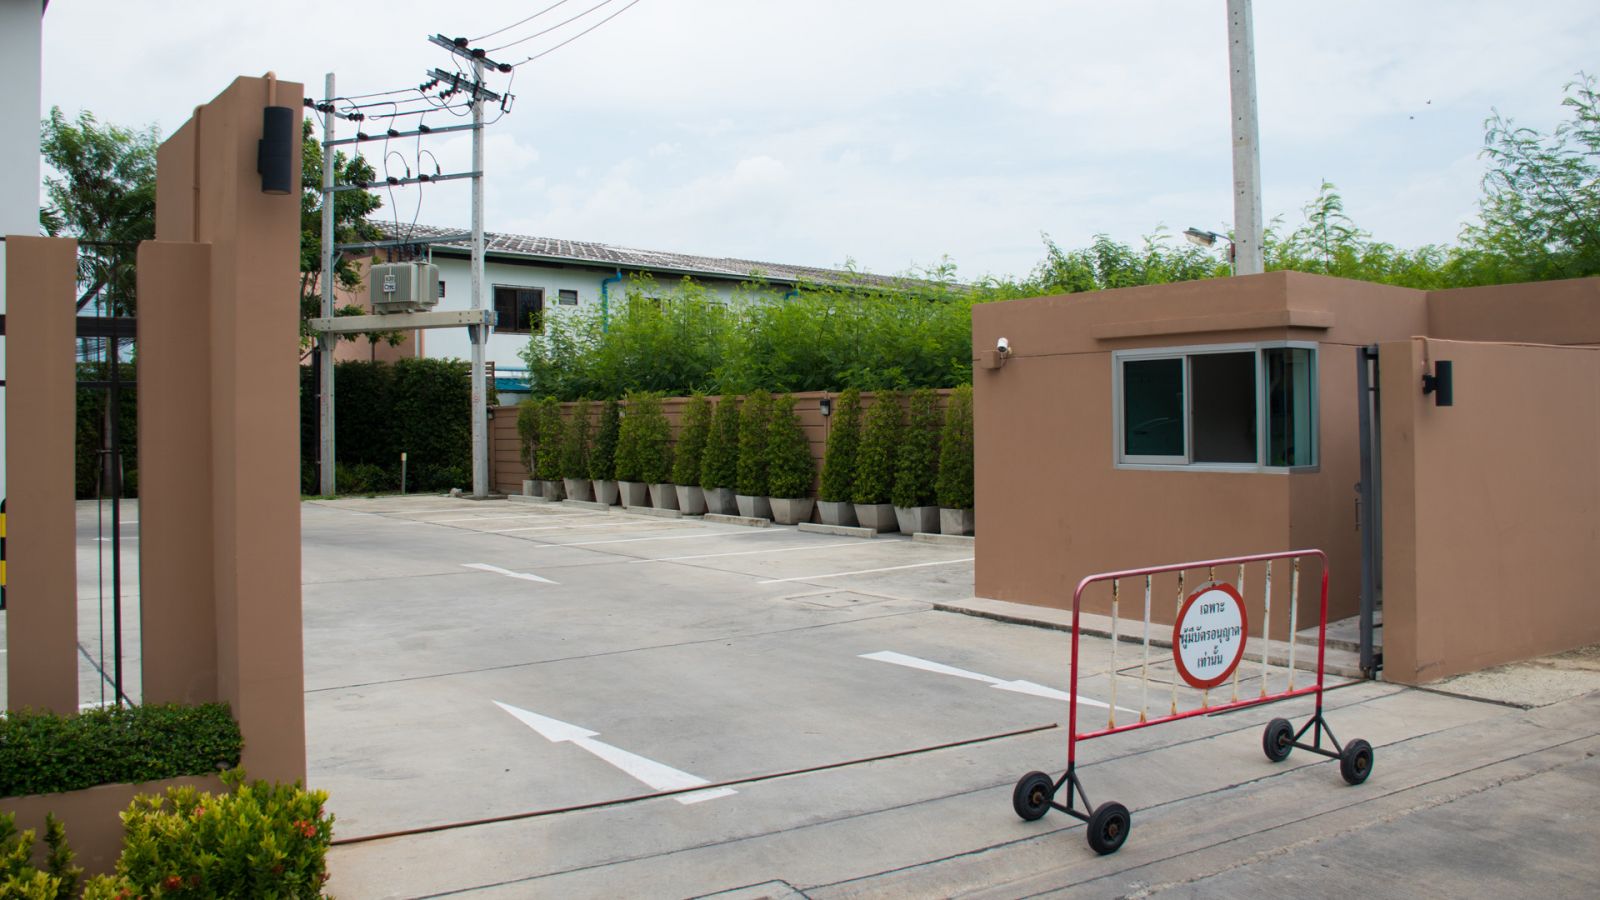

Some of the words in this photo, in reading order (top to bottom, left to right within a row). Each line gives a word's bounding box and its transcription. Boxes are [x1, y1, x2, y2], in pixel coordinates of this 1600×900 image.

[1200, 602, 1225, 615] เฉพาะ
[1181, 626, 1240, 649] ผู้มีบัตรอนุญาต
[1197, 645, 1223, 668] เท่านั้น
